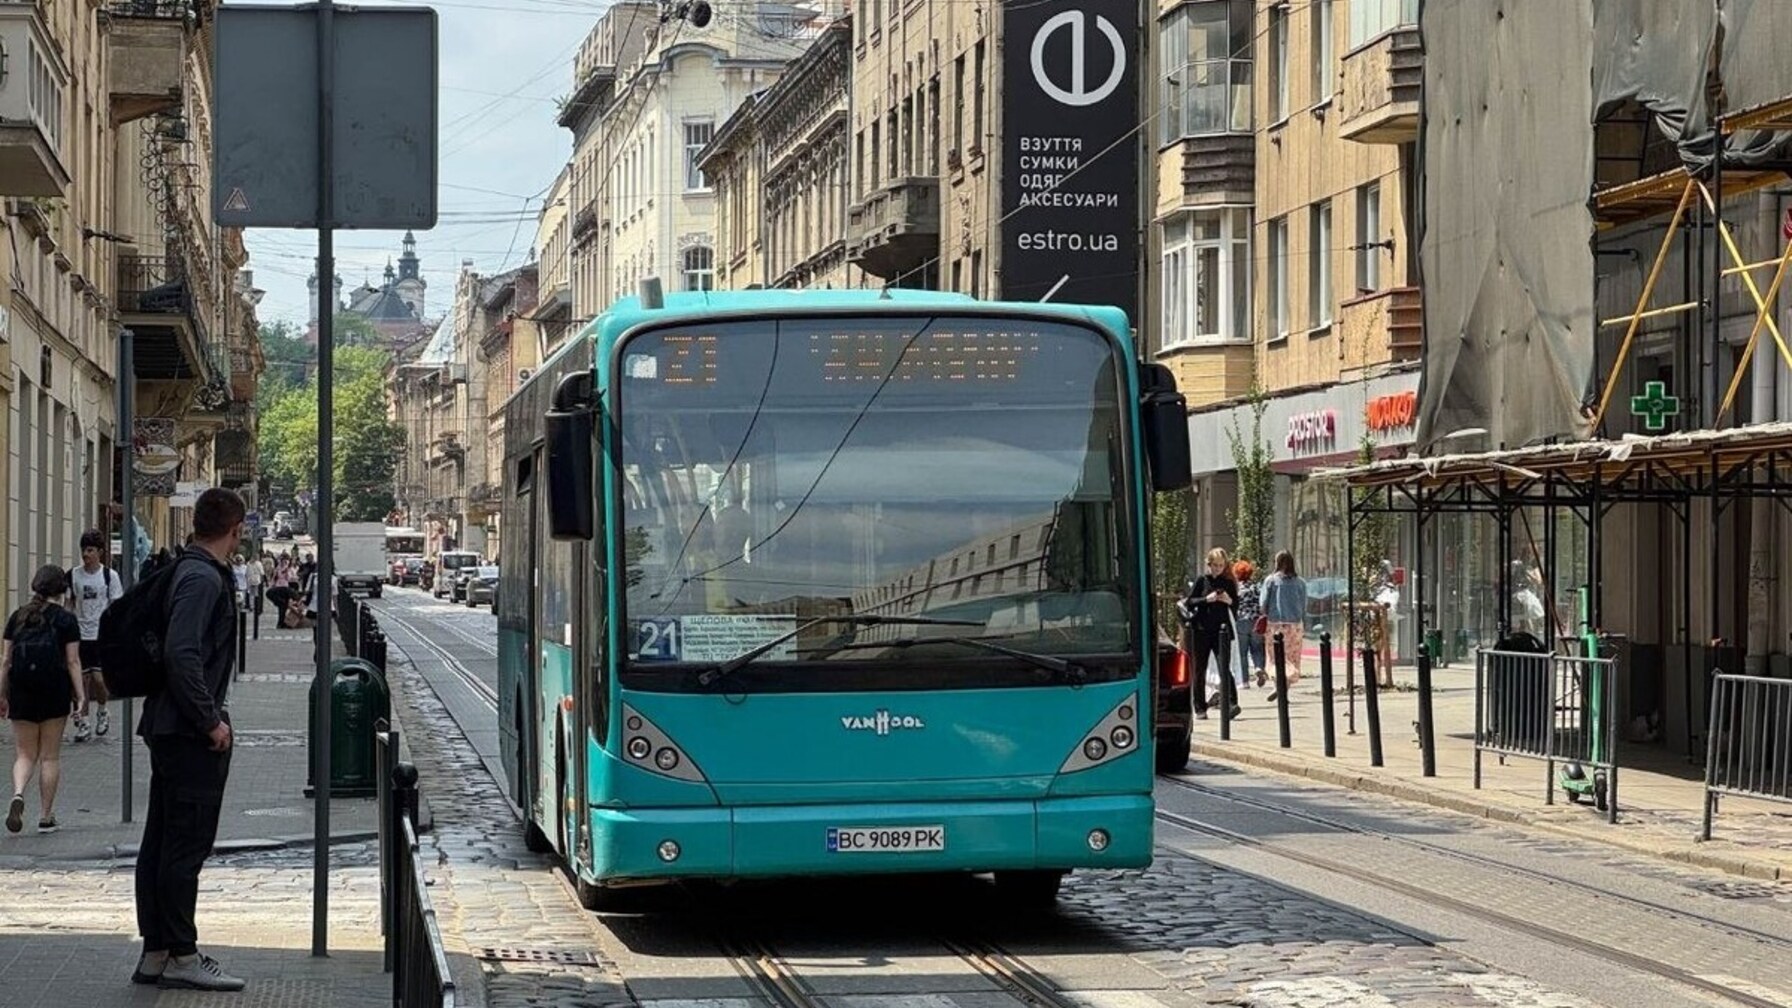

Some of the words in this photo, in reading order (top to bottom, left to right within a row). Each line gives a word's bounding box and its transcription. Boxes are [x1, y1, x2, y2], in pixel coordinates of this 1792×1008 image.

[1020, 137, 1082, 152] ВЗУТТЯ
[1020, 156, 1078, 170] СУМКИ
[1020, 174, 1063, 189] ОДЯГ
[1019, 193, 1118, 207] АКСЕСУАРИ
[1018, 230, 1118, 251] estro.ua
[640, 622, 677, 655] 21
[839, 832, 865, 848] BC
[869, 831, 911, 848] 9089
[915, 830, 941, 847] PK
